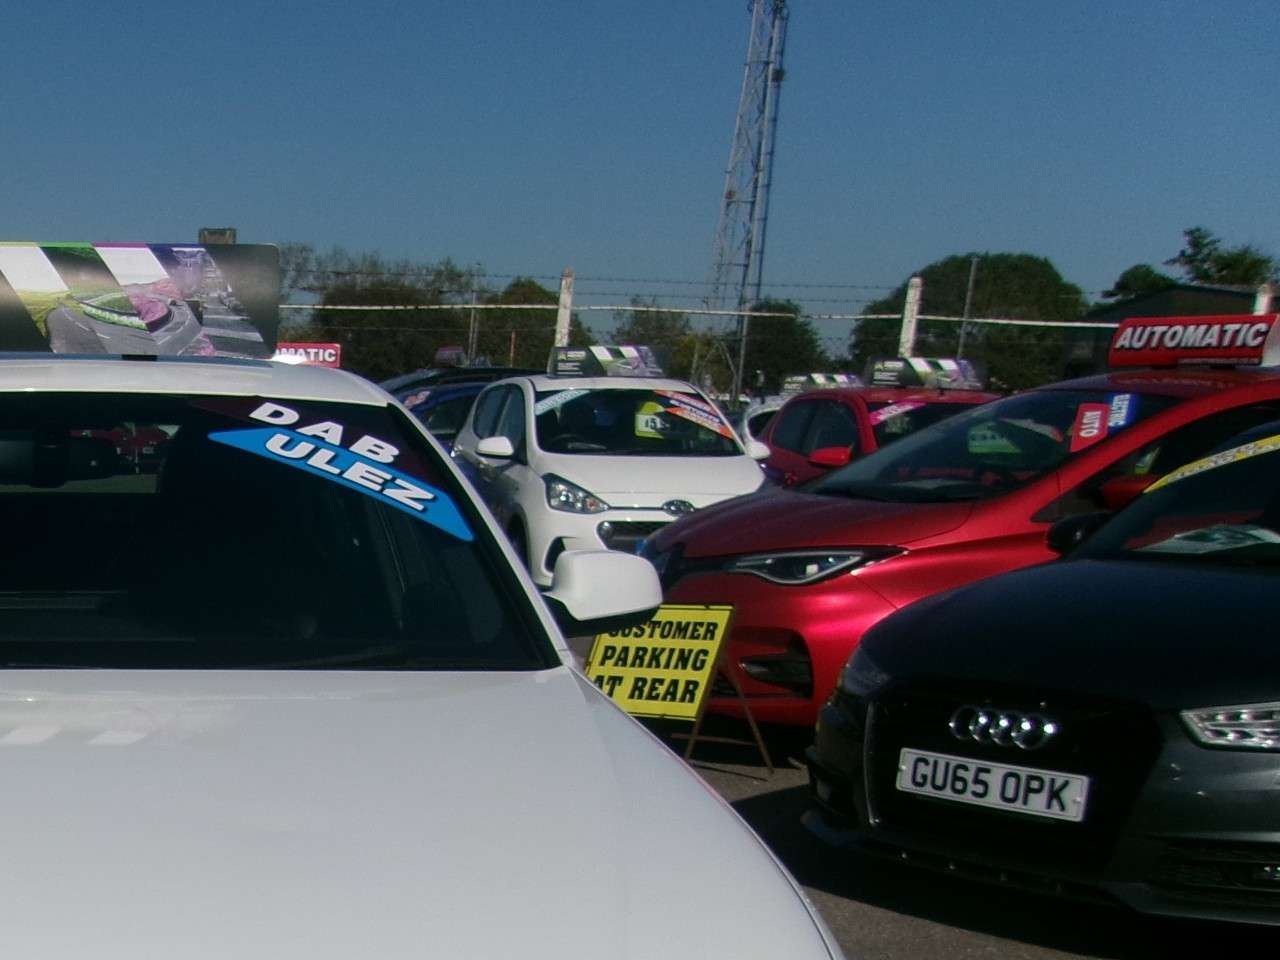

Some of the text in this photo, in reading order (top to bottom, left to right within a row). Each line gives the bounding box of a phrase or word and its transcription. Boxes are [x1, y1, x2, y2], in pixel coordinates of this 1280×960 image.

[1115, 323, 1269, 349] AUTOMATIC
[249, 402, 400, 464] DAB
[1079, 411, 1102, 438] AUTO
[265, 433, 435, 511] ULEZ
[599, 645, 709, 671] PARKING
[628, 677, 699, 703] REAR
[911, 757, 1070, 812] GU65 OPK
